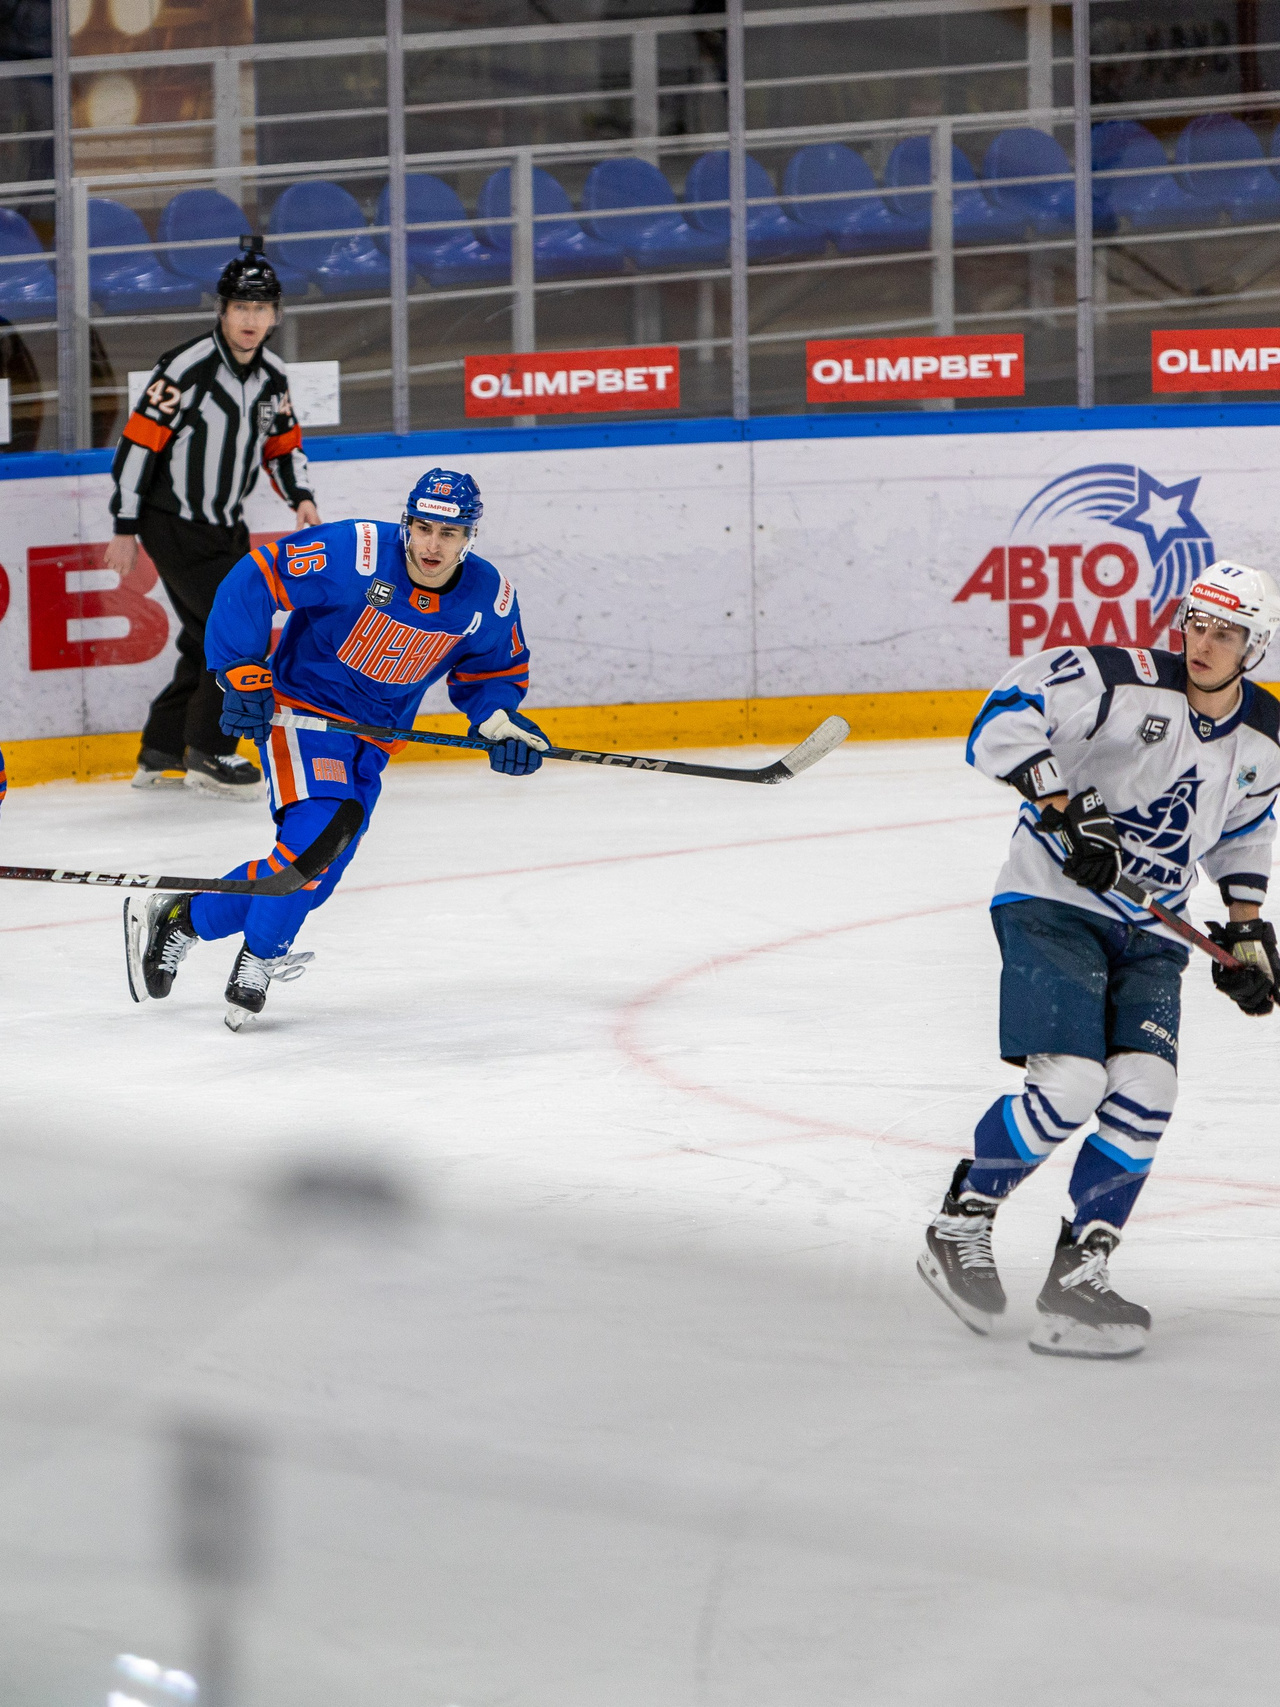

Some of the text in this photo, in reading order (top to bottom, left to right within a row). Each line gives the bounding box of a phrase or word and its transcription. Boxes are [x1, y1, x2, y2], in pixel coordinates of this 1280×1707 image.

[812, 353, 1018, 384] OLIMPBET
[1157, 347, 1280, 374] OLIMP
[470, 365, 673, 399] OLIMPBET
[146, 379, 181, 415] 42
[433, 482, 453, 495] 16
[419, 502, 457, 513] OLIMPBET
[286, 541, 327, 577] 16
[952, 542, 1140, 603] АВТО
[1221, 567, 1243, 577] 47
[1195, 587, 1237, 606] OLIMPBET
[510, 621, 524, 658] 1
[1009, 598, 1188, 657] РАДИ
[240, 673, 272, 686] CC
[385, 731, 486, 750] JETSPEED
[570, 751, 668, 772] CCM
[51, 869, 161, 888] CCM
[1129, 857, 1183, 885] ТАЙ
